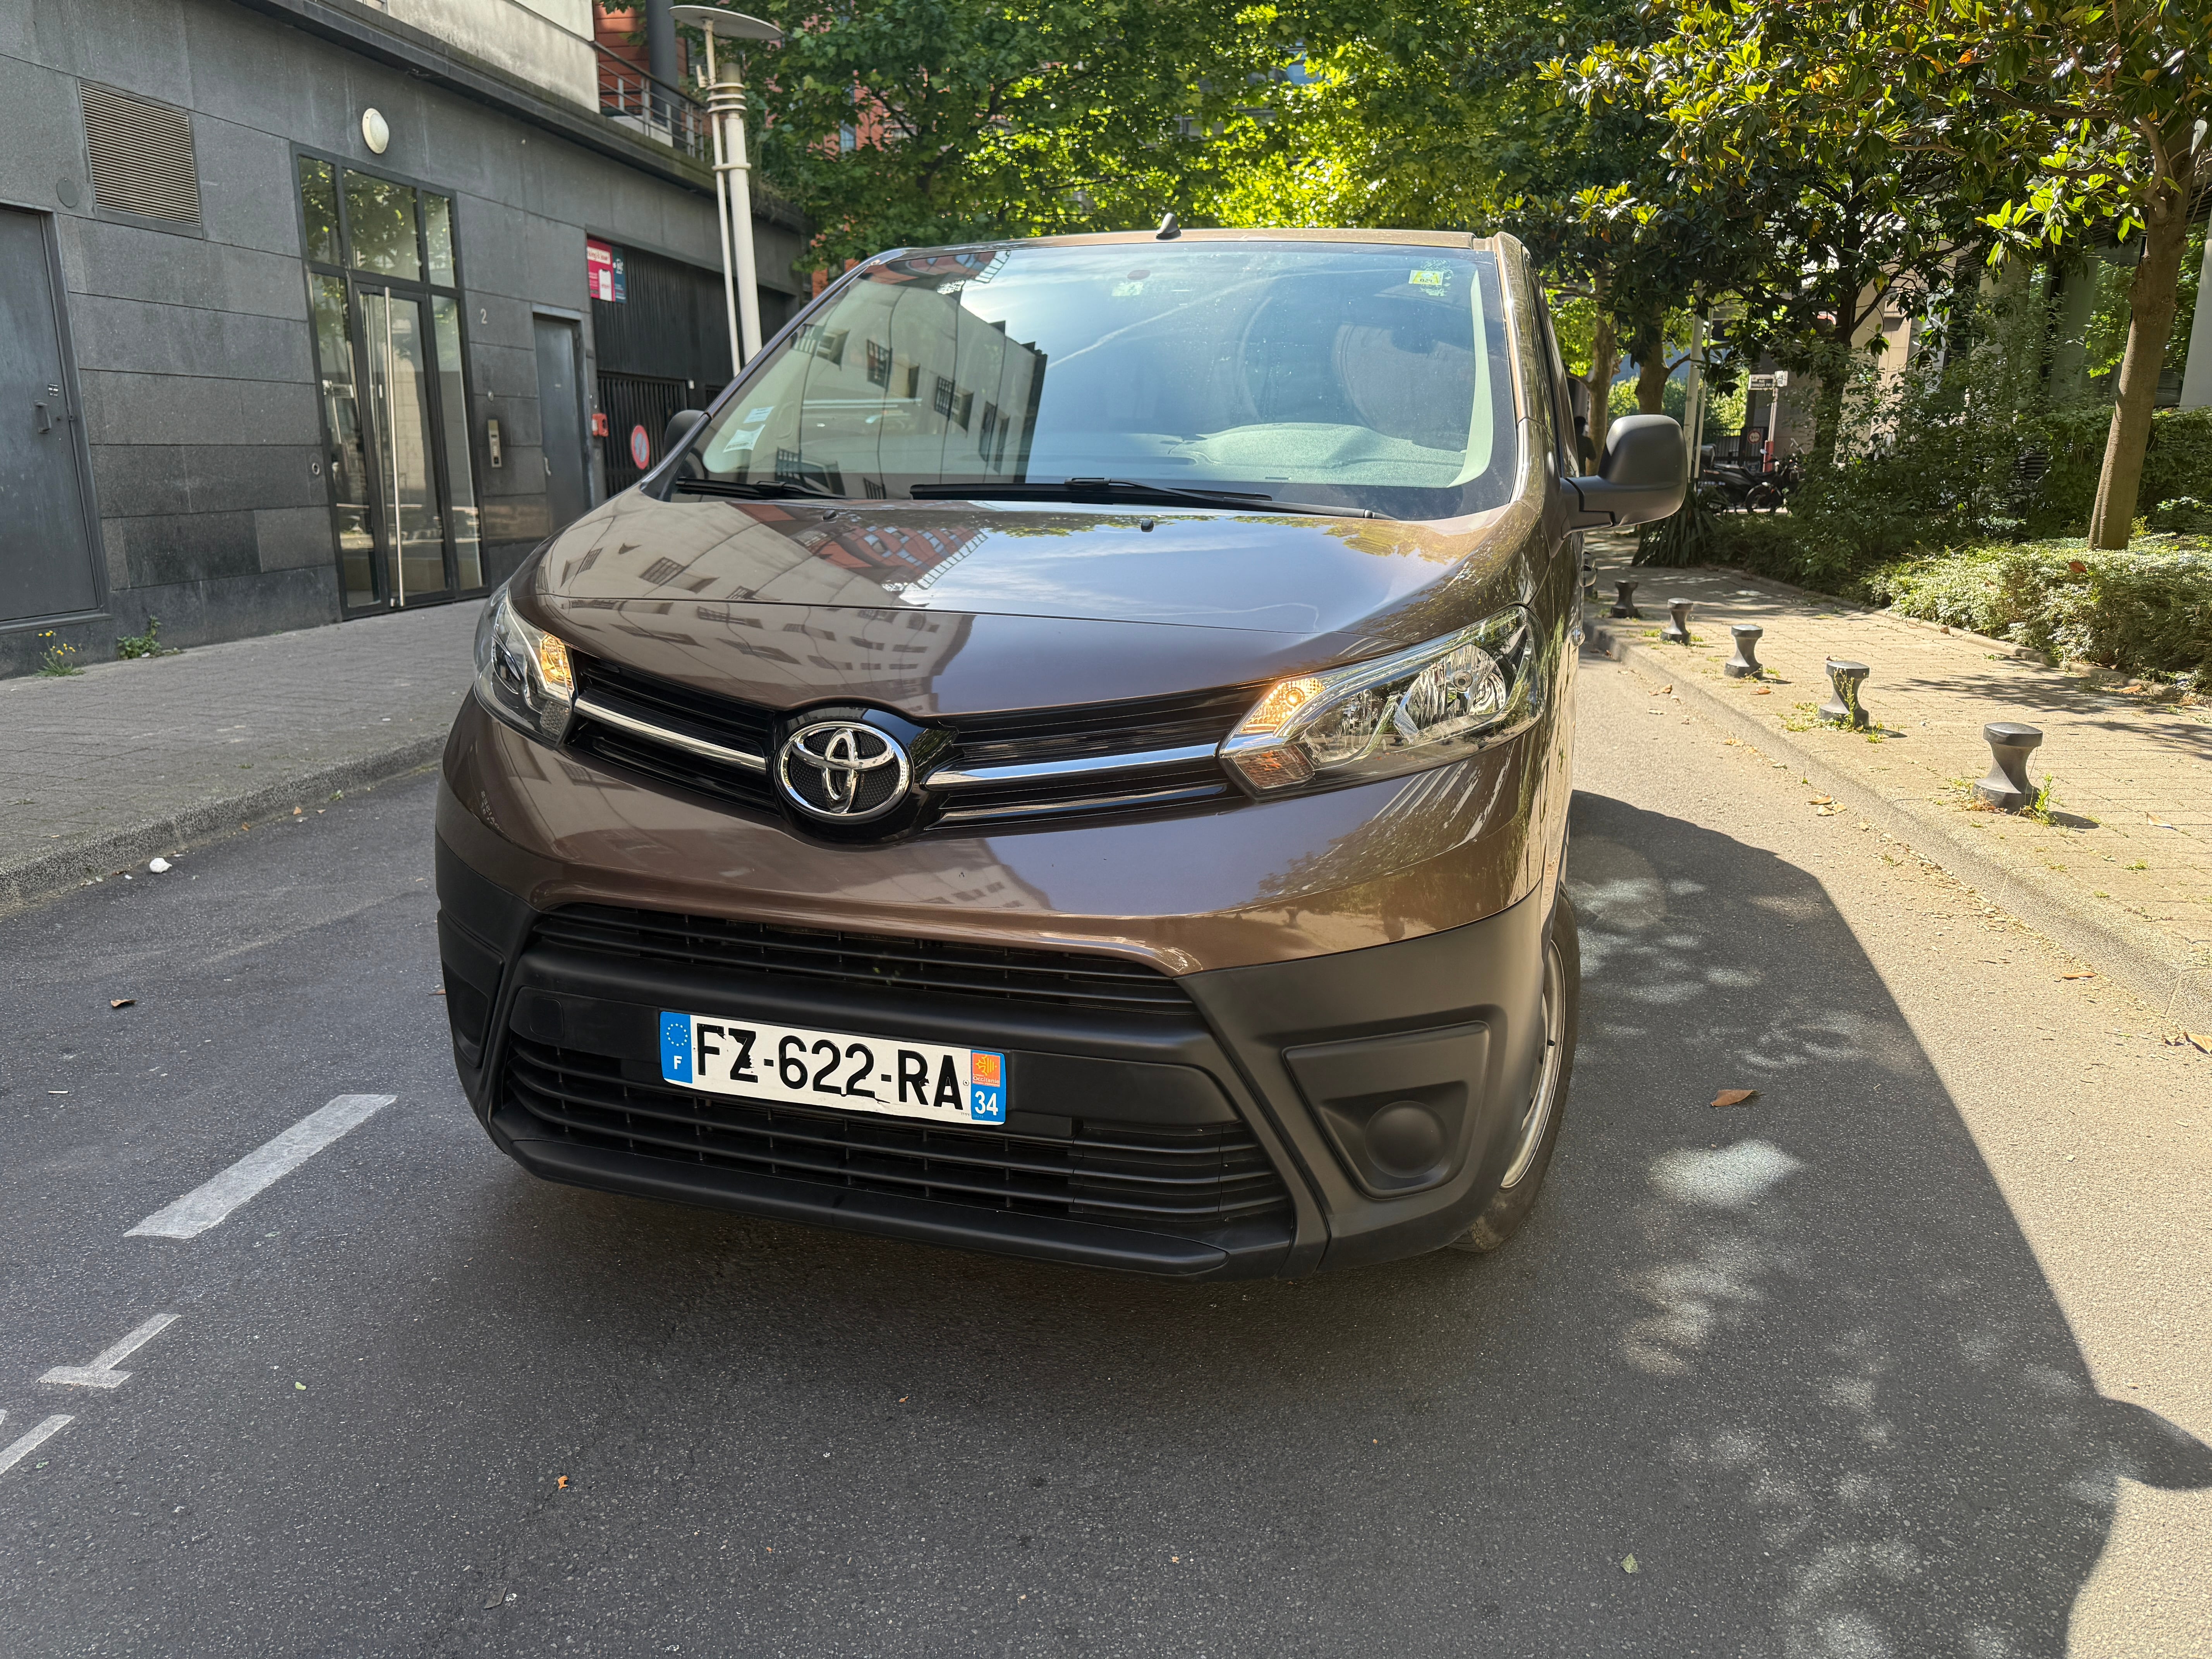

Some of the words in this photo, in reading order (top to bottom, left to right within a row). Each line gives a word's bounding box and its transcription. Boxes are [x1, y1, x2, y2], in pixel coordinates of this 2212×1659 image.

[480, 308, 488, 325] 2
[673, 1056, 682, 1070] F
[697, 1023, 963, 1110] FZ-622-RA
[973, 1076, 1000, 1084] Occitanie
[975, 1091, 998, 1116] 34
